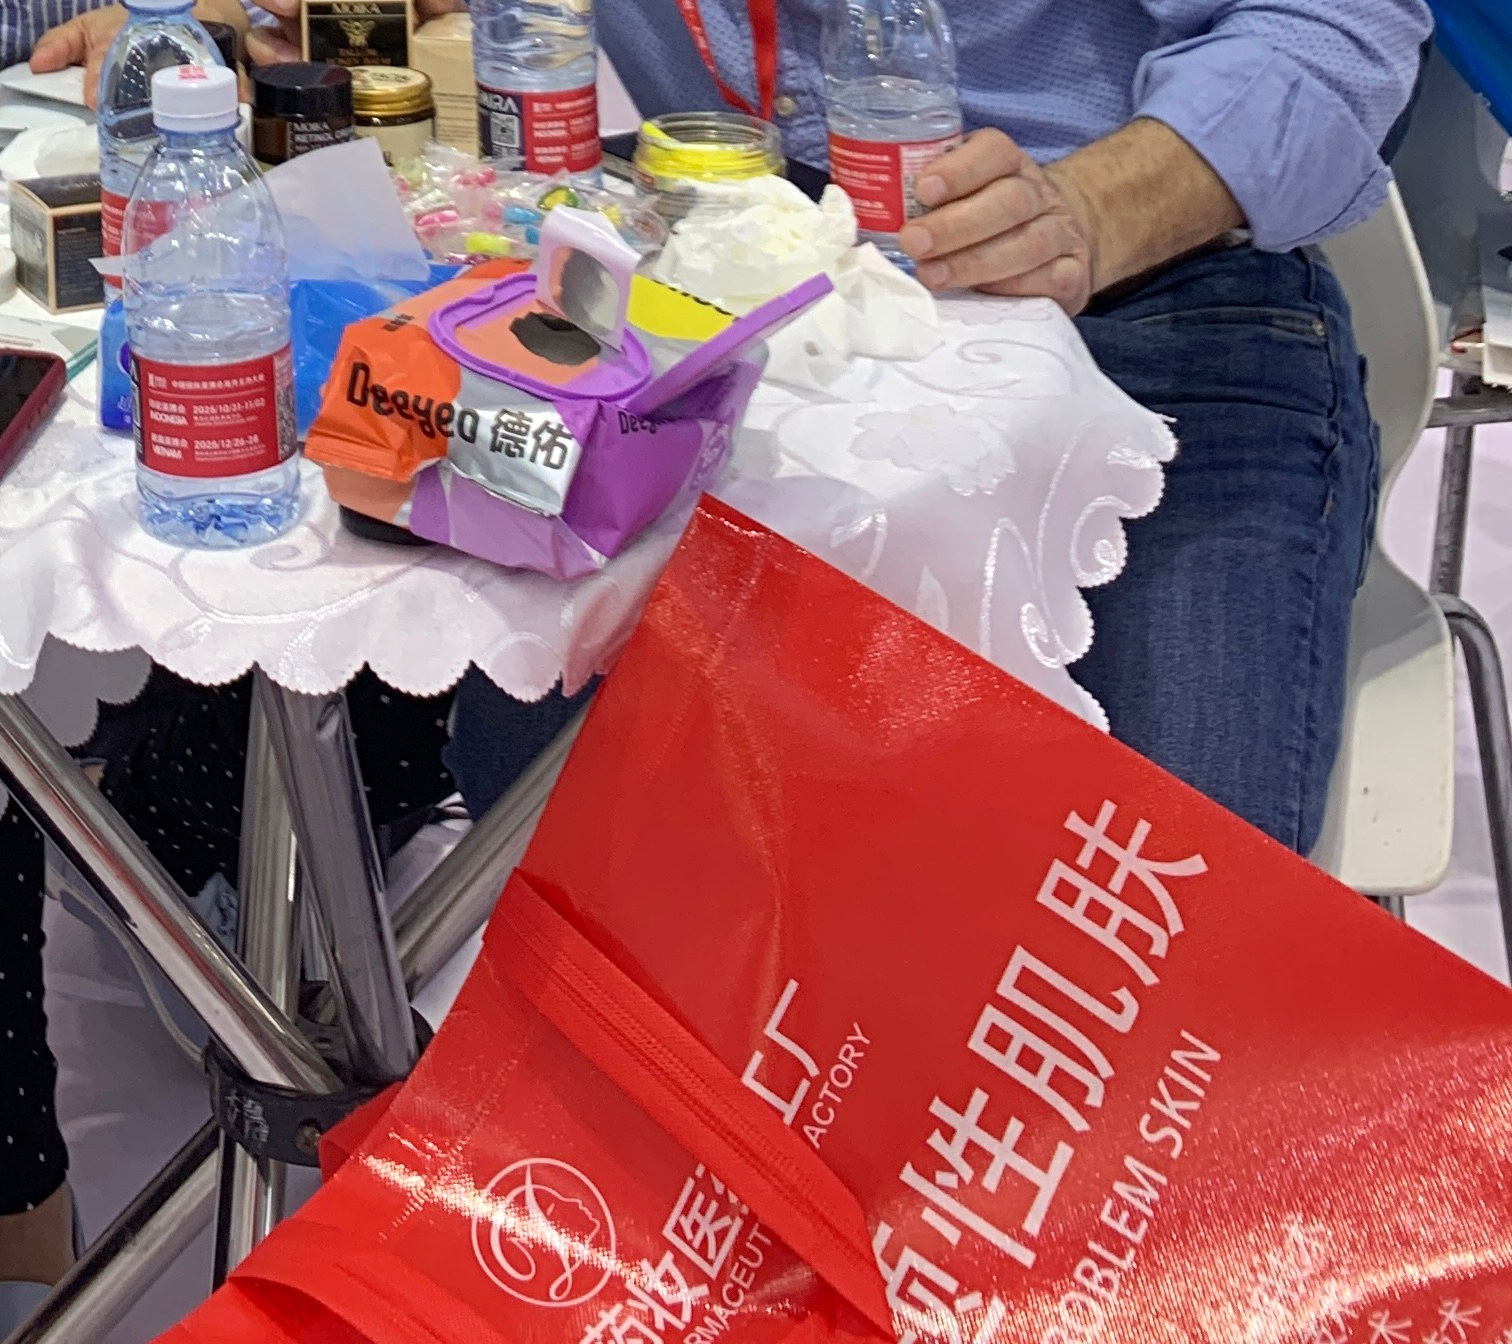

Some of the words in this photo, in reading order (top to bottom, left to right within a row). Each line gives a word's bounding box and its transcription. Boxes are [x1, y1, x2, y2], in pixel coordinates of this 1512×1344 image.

[347, 362, 479, 445] Deeyeo
[489, 408, 575, 470] 德佑
[1139, 1029, 1222, 1159] SKIN
